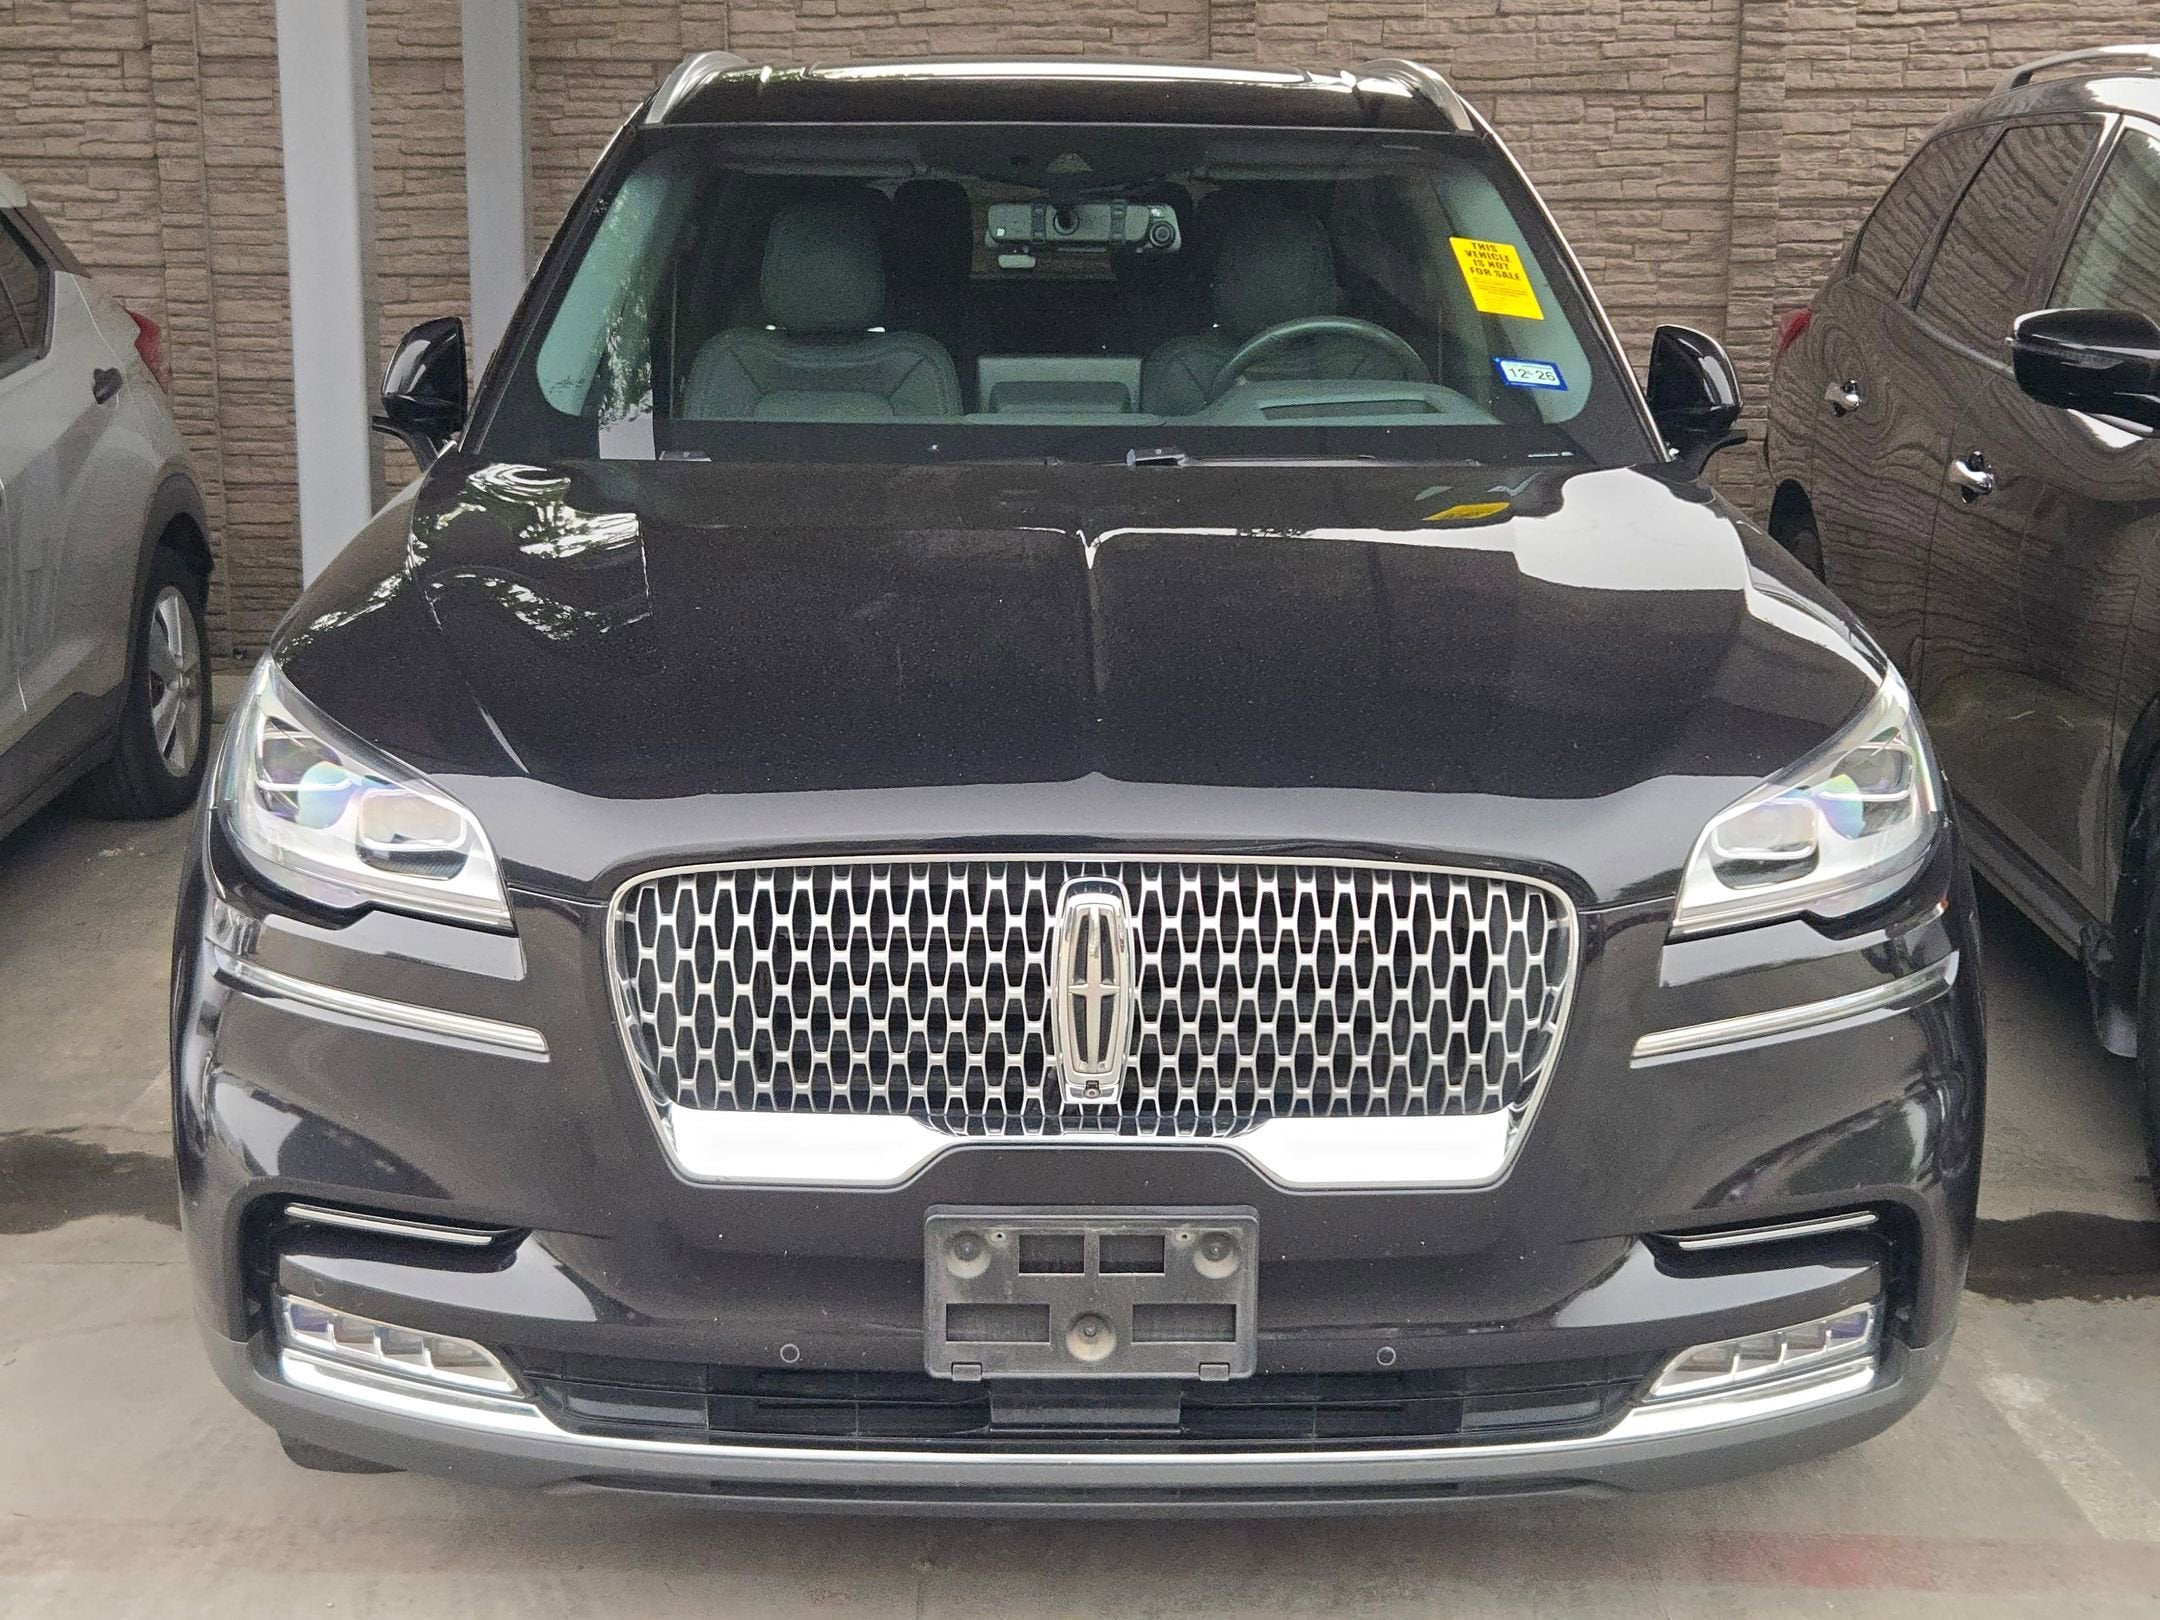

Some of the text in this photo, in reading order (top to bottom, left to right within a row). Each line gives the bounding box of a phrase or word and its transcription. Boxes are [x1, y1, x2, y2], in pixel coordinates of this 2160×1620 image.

[1472, 242, 1498, 252] THIS
[1464, 249, 1512, 263] VEHICLE
[1473, 259, 1509, 271] IS NOT
[1469, 267, 1521, 281] FOR SALE
